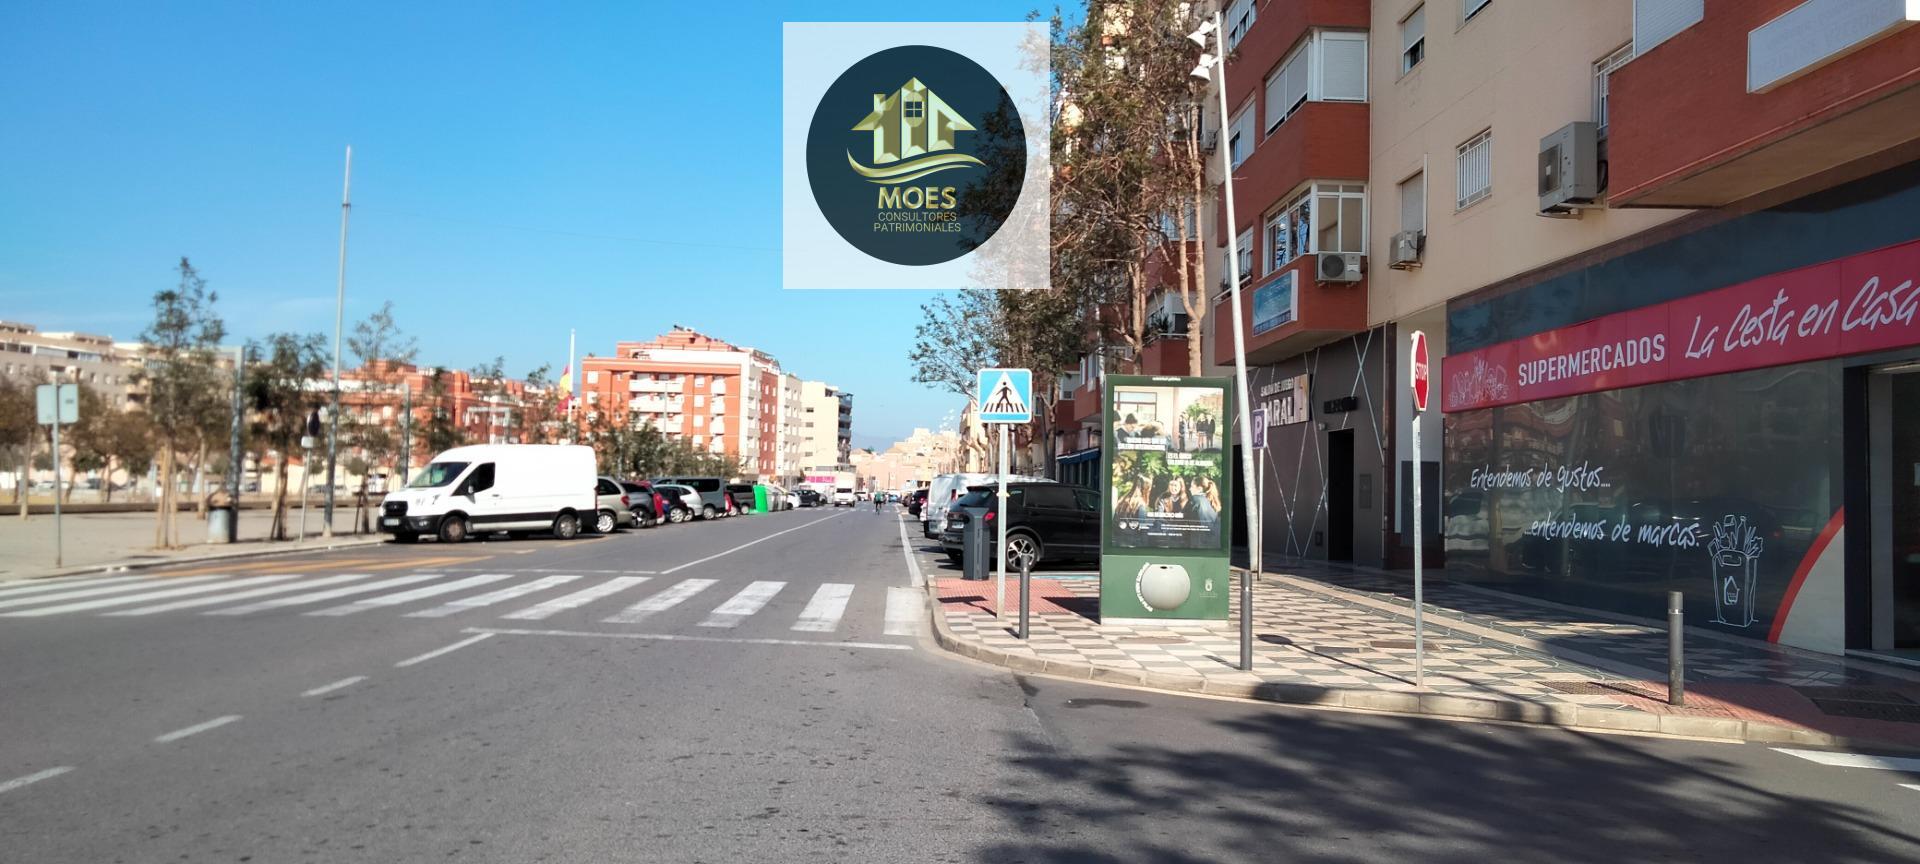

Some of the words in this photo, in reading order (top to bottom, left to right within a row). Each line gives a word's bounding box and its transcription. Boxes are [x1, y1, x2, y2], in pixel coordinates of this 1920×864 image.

[1685, 314, 1719, 359] La
[1723, 288, 1795, 352] Cesta
[1797, 300, 1839, 337] en
[1841, 276, 1920, 331] Casa
[1518, 333, 1665, 386] SUPERMERCADOS
[1470, 464, 1533, 490] Entendemos
[1536, 463, 1551, 486] de
[1611, 514, 1635, 542] de
